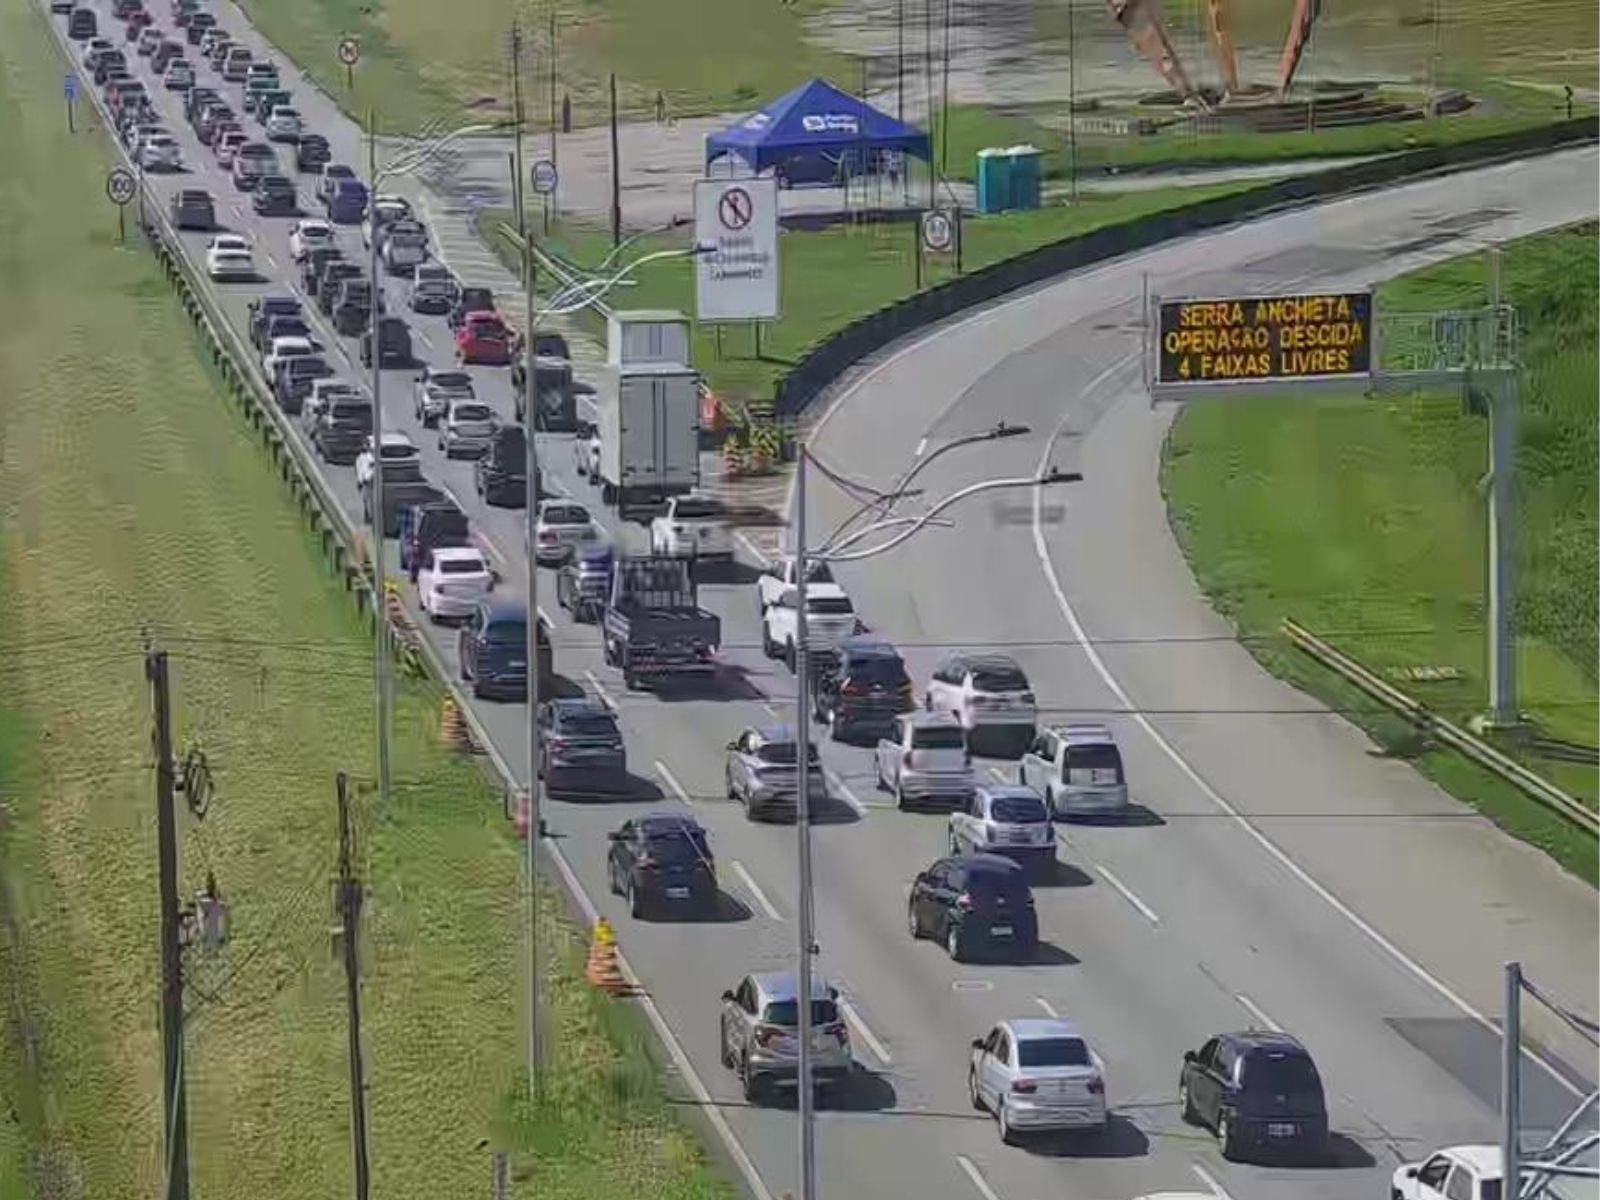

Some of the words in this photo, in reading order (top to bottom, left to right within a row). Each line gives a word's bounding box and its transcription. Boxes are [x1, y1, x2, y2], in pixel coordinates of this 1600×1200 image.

[1180, 302, 1244, 326] SERRA
[1255, 296, 1349, 323] ANCHIETA
[1280, 321, 1363, 349] DESCIDA
[1178, 356, 1191, 378] 4
[1200, 353, 1271, 378] FAIXAS
[1281, 348, 1349, 374] LIVRES
